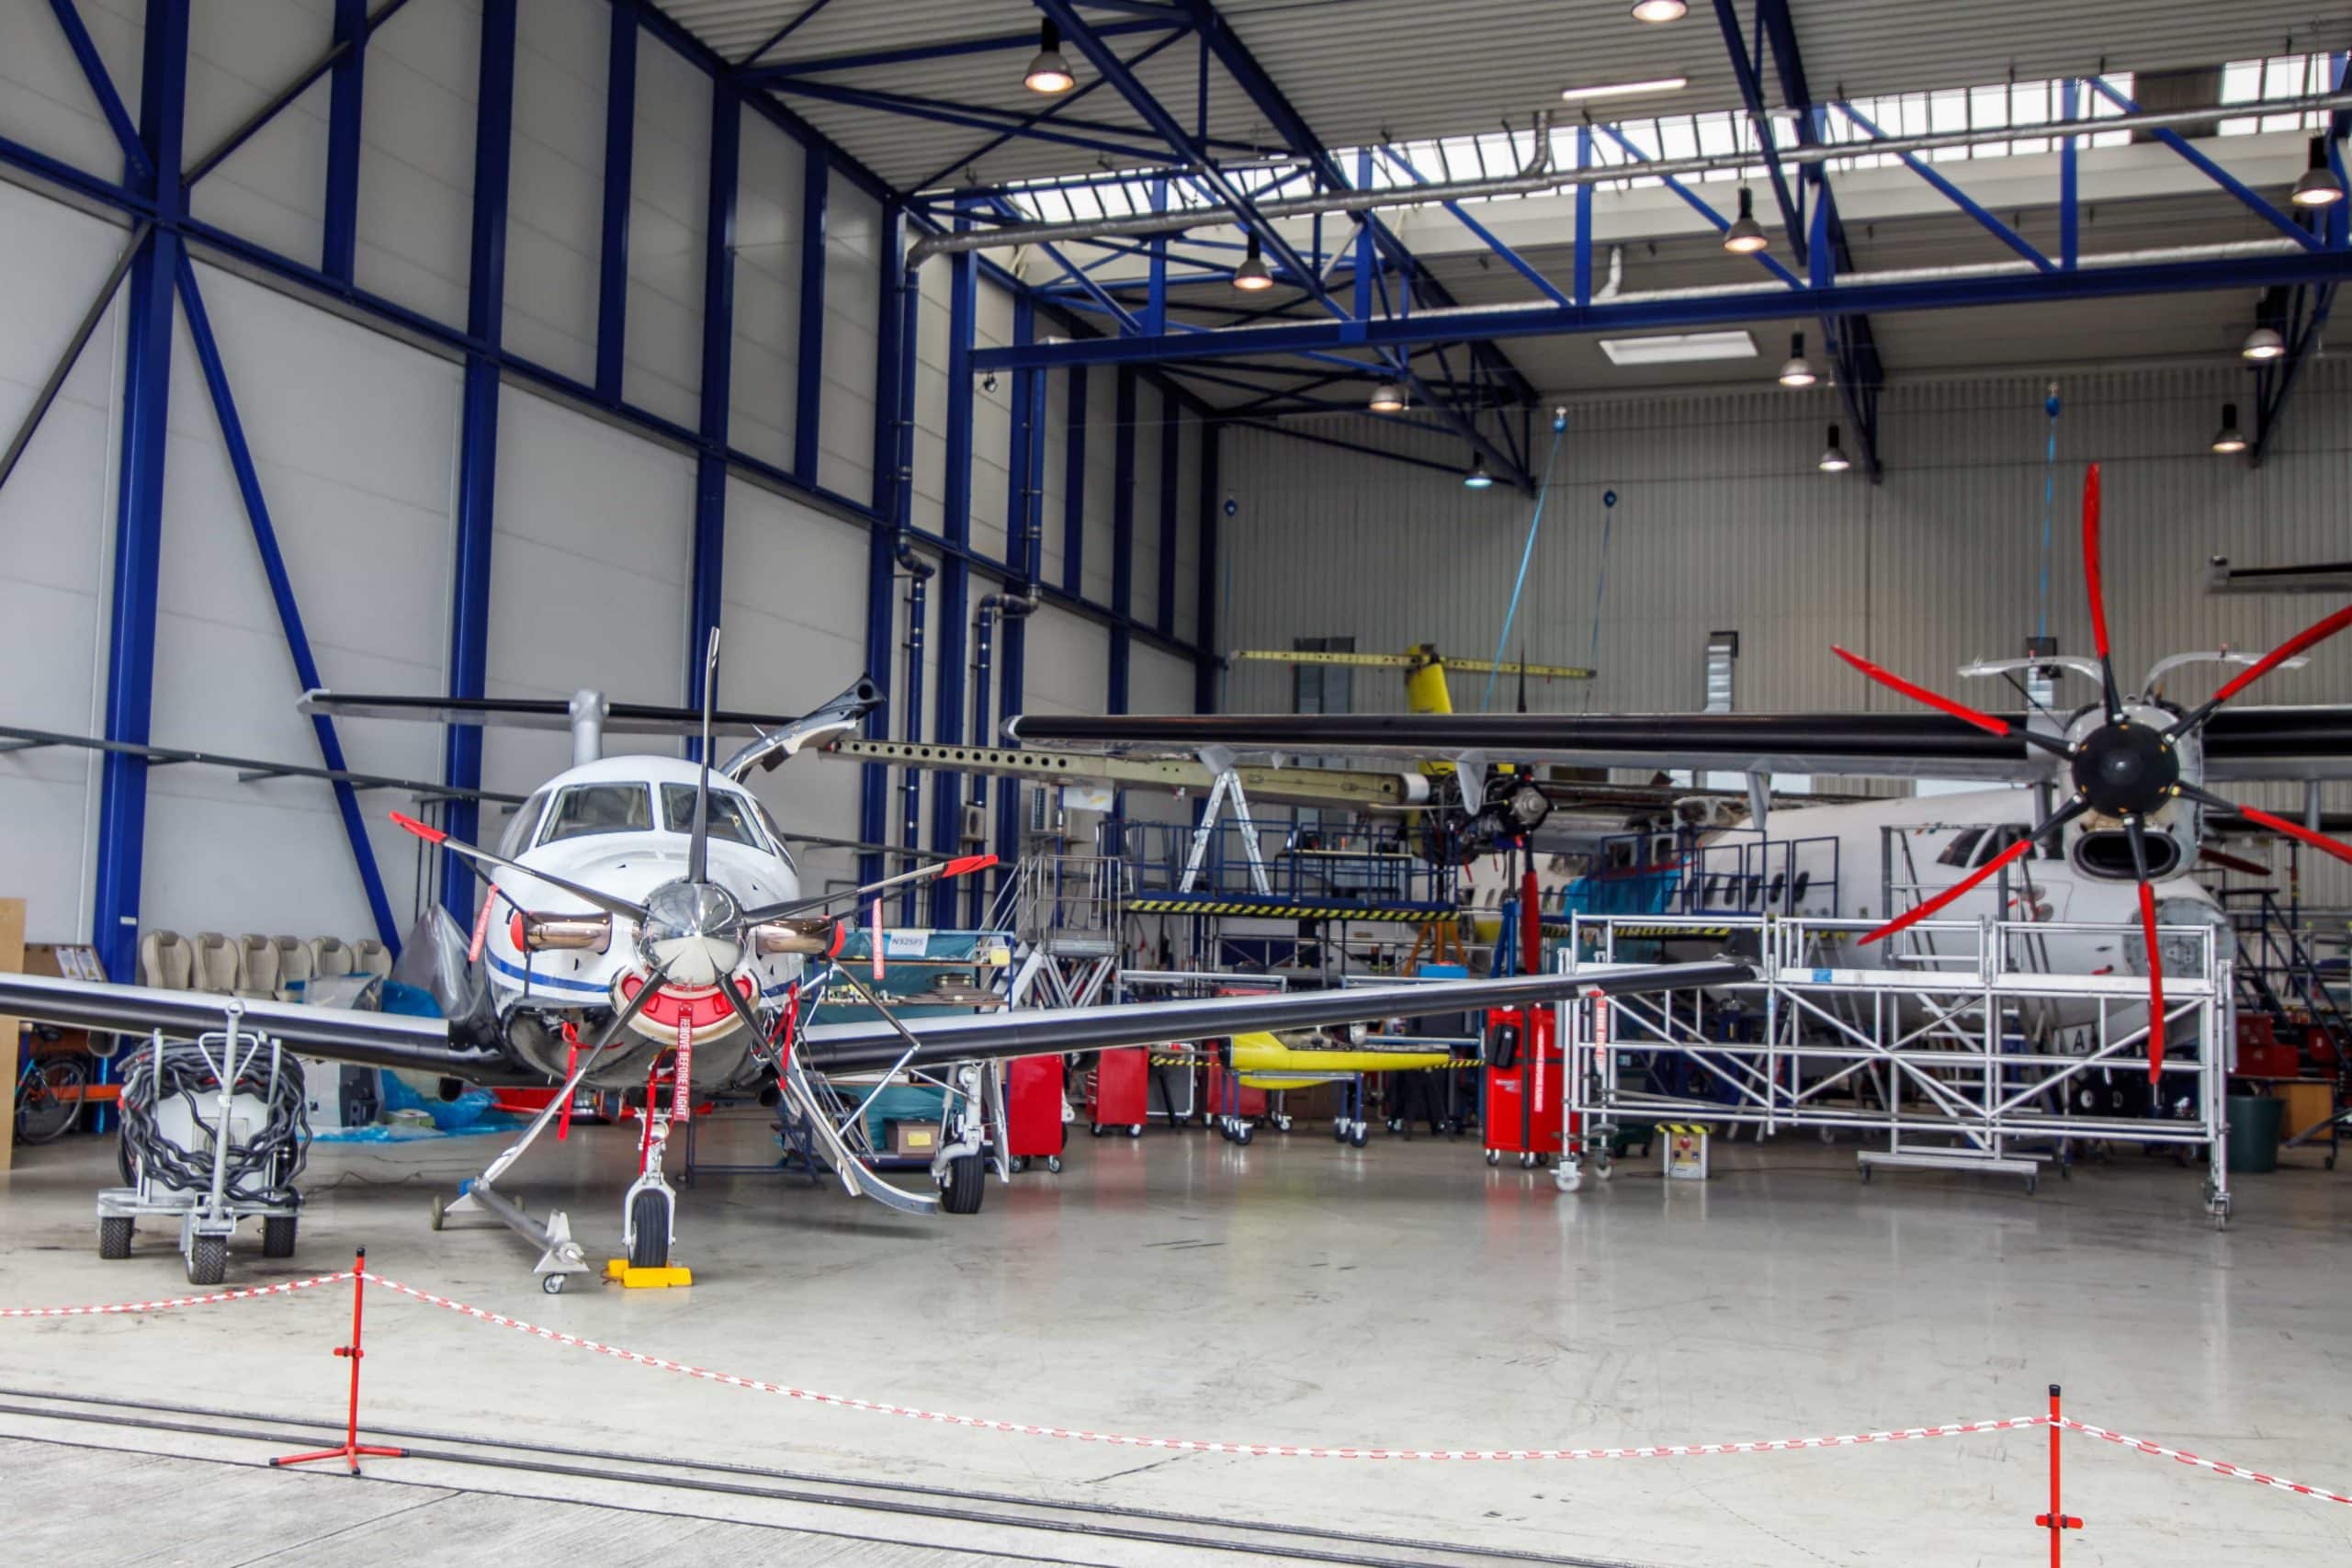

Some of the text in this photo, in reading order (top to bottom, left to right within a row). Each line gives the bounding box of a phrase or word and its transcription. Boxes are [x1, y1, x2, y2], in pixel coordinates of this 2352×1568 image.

[675, 1018, 691, 1117] REMOVE BEFORE FLIGHT
[2073, 1030, 2086, 1053] A
